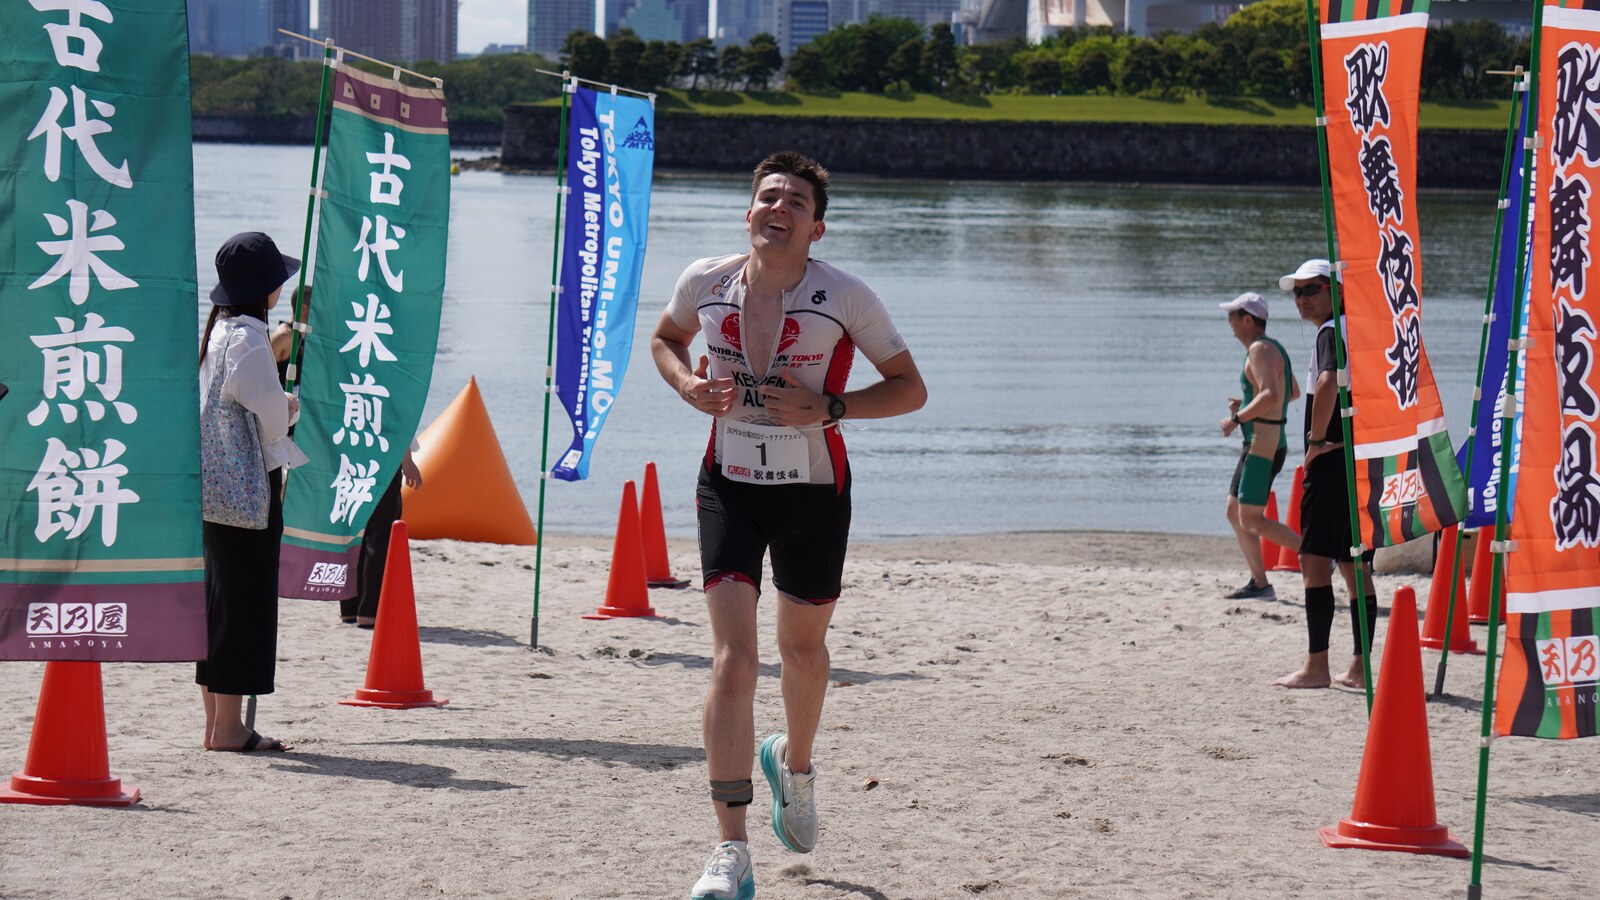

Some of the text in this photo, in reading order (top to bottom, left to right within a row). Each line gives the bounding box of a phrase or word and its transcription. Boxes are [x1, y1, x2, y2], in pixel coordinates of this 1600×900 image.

[599, 110, 624, 229] TOKYO
[28, 0, 140, 547] 古代米煎餅
[574, 127, 601, 416] Tokyo Metropolitan Triathlon
[330, 132, 412, 527] 古代米煎餅
[791, 353, 824, 362] TOKYO
[731, 370, 786, 389] KEEN
[755, 442, 767, 466] 1
[1380, 470, 1424, 505] 天乃
[27, 603, 126, 633] 天乃屋
[29, 639, 123, 648] AMANOYA
